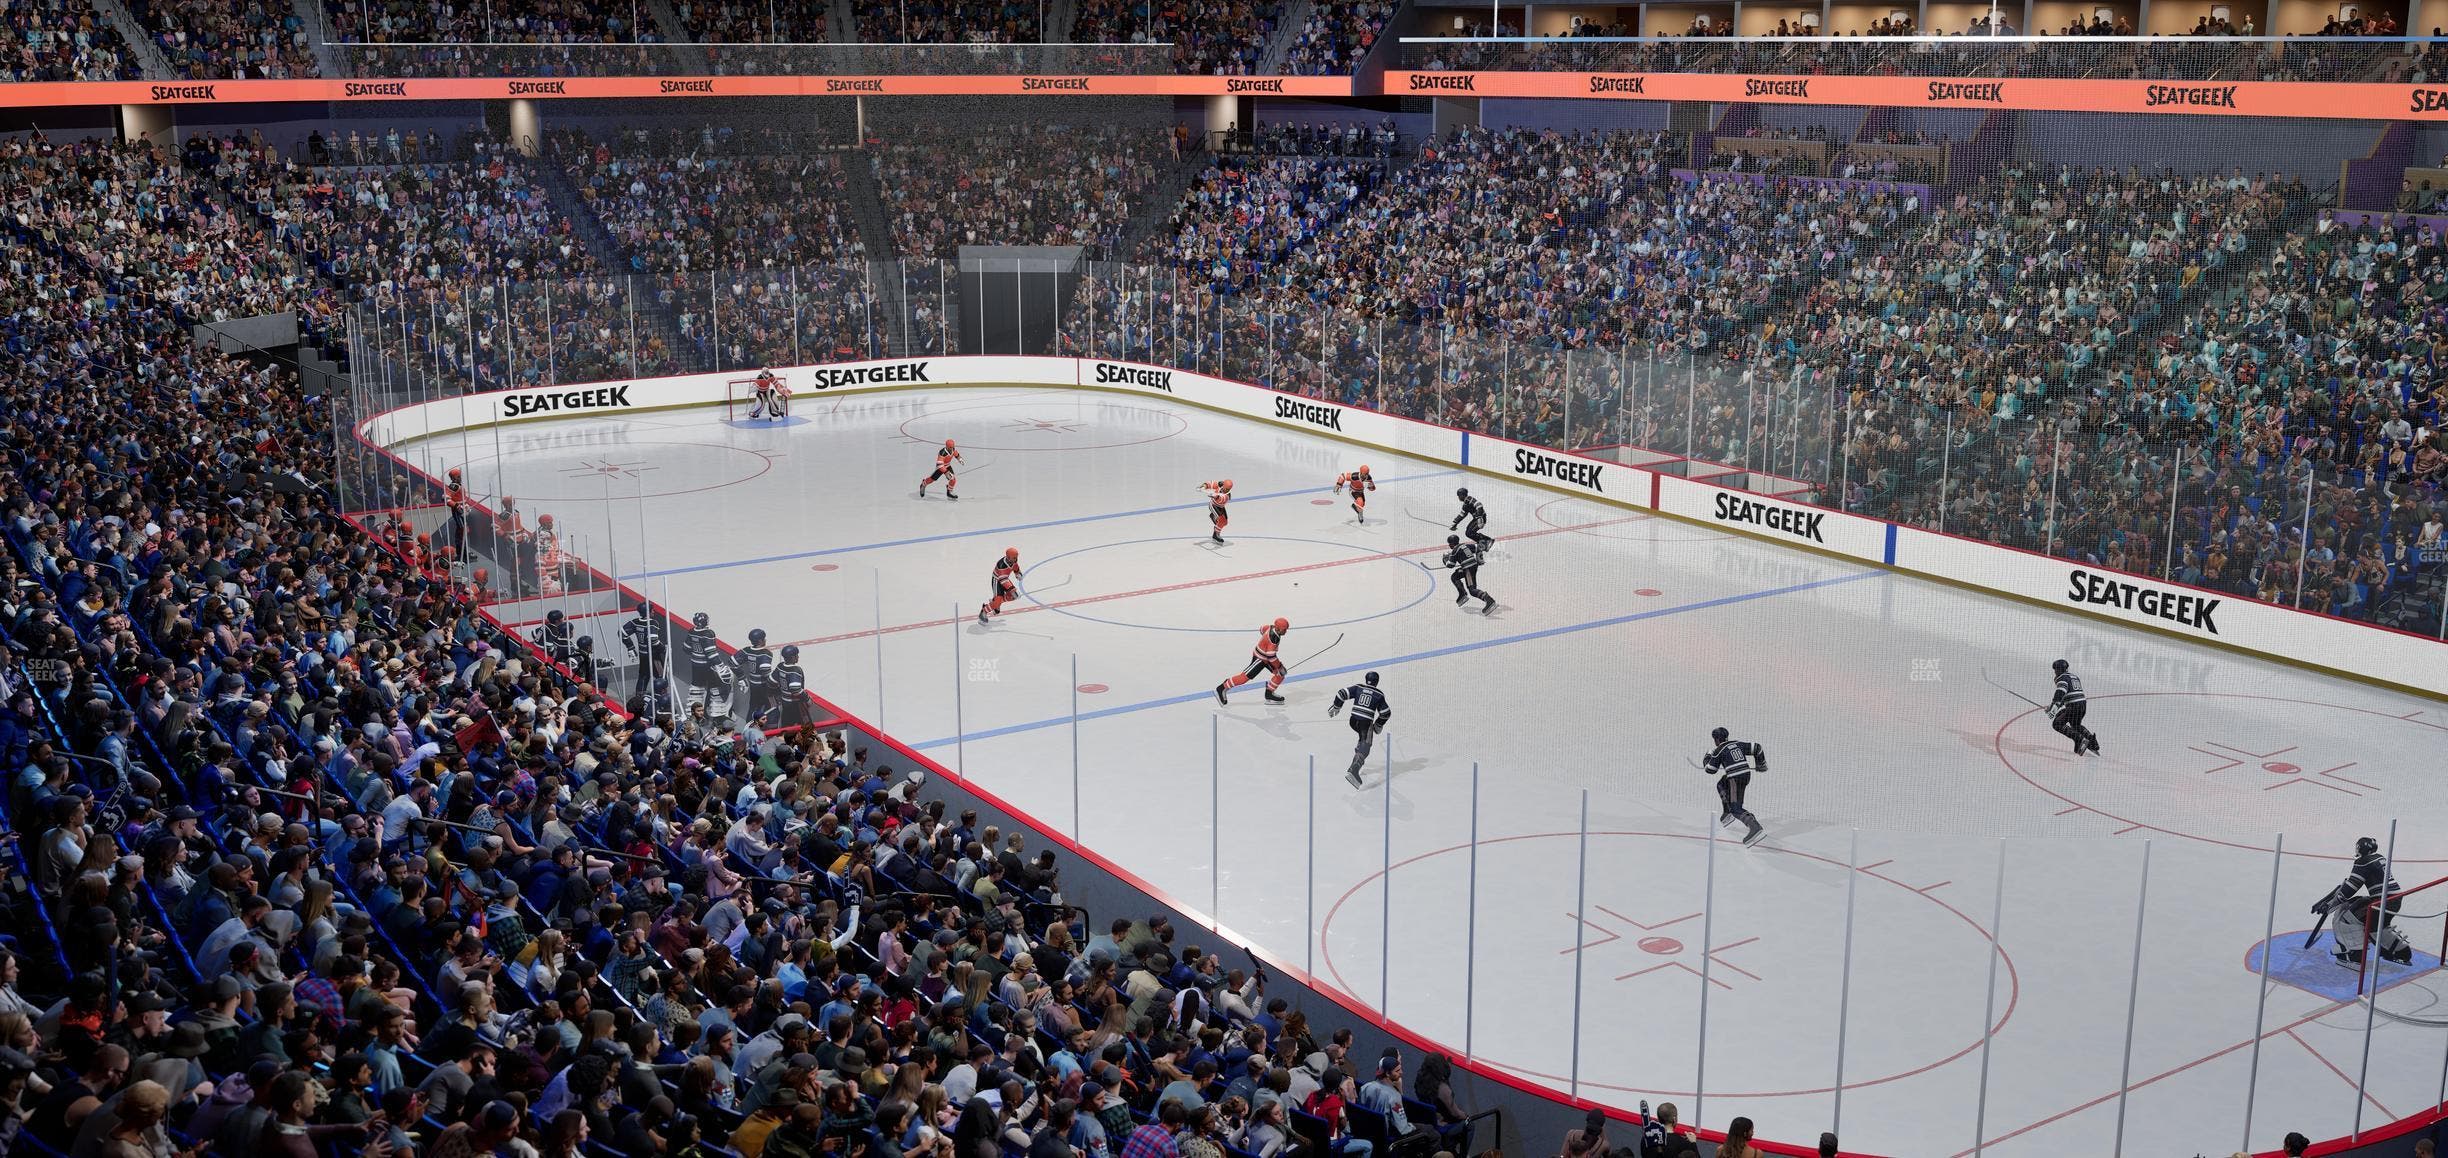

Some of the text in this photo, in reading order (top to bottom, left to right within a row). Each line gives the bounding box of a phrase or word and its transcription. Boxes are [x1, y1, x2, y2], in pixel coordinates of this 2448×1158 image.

[345, 82, 406, 96] SEATGEEK
[509, 81, 565, 95] SEATGEEK
[661, 80, 713, 93] SEATGEEK
[827, 79, 883, 91] SEATGEEK
[1023, 78, 1089, 90] SEATGEEK
[1227, 79, 1283, 92] SEATGEEK
[1410, 75, 1474, 91] SEATGEEK
[1591, 77, 1643, 94] SEATGEEK
[1746, 79, 1808, 97] SEATGEEK
[152, 85, 216, 100] SEATGEEK
[1928, 82, 2003, 102] SEATGEEK
[2146, 85, 2237, 109] SEATGEEK
[815, 362, 930, 389] SEATGEEK
[1097, 363, 1172, 392] SEATGEEK
[504, 385, 630, 416] SEATGEEK
[1276, 396, 1341, 431] SEATGEEK
[1516, 449, 1603, 492] SEATGEEK
[1716, 493, 1825, 544] SEATGEEK
[2069, 570, 2220, 634] SEATGEEK
[1358, 694, 1372, 707] 00
